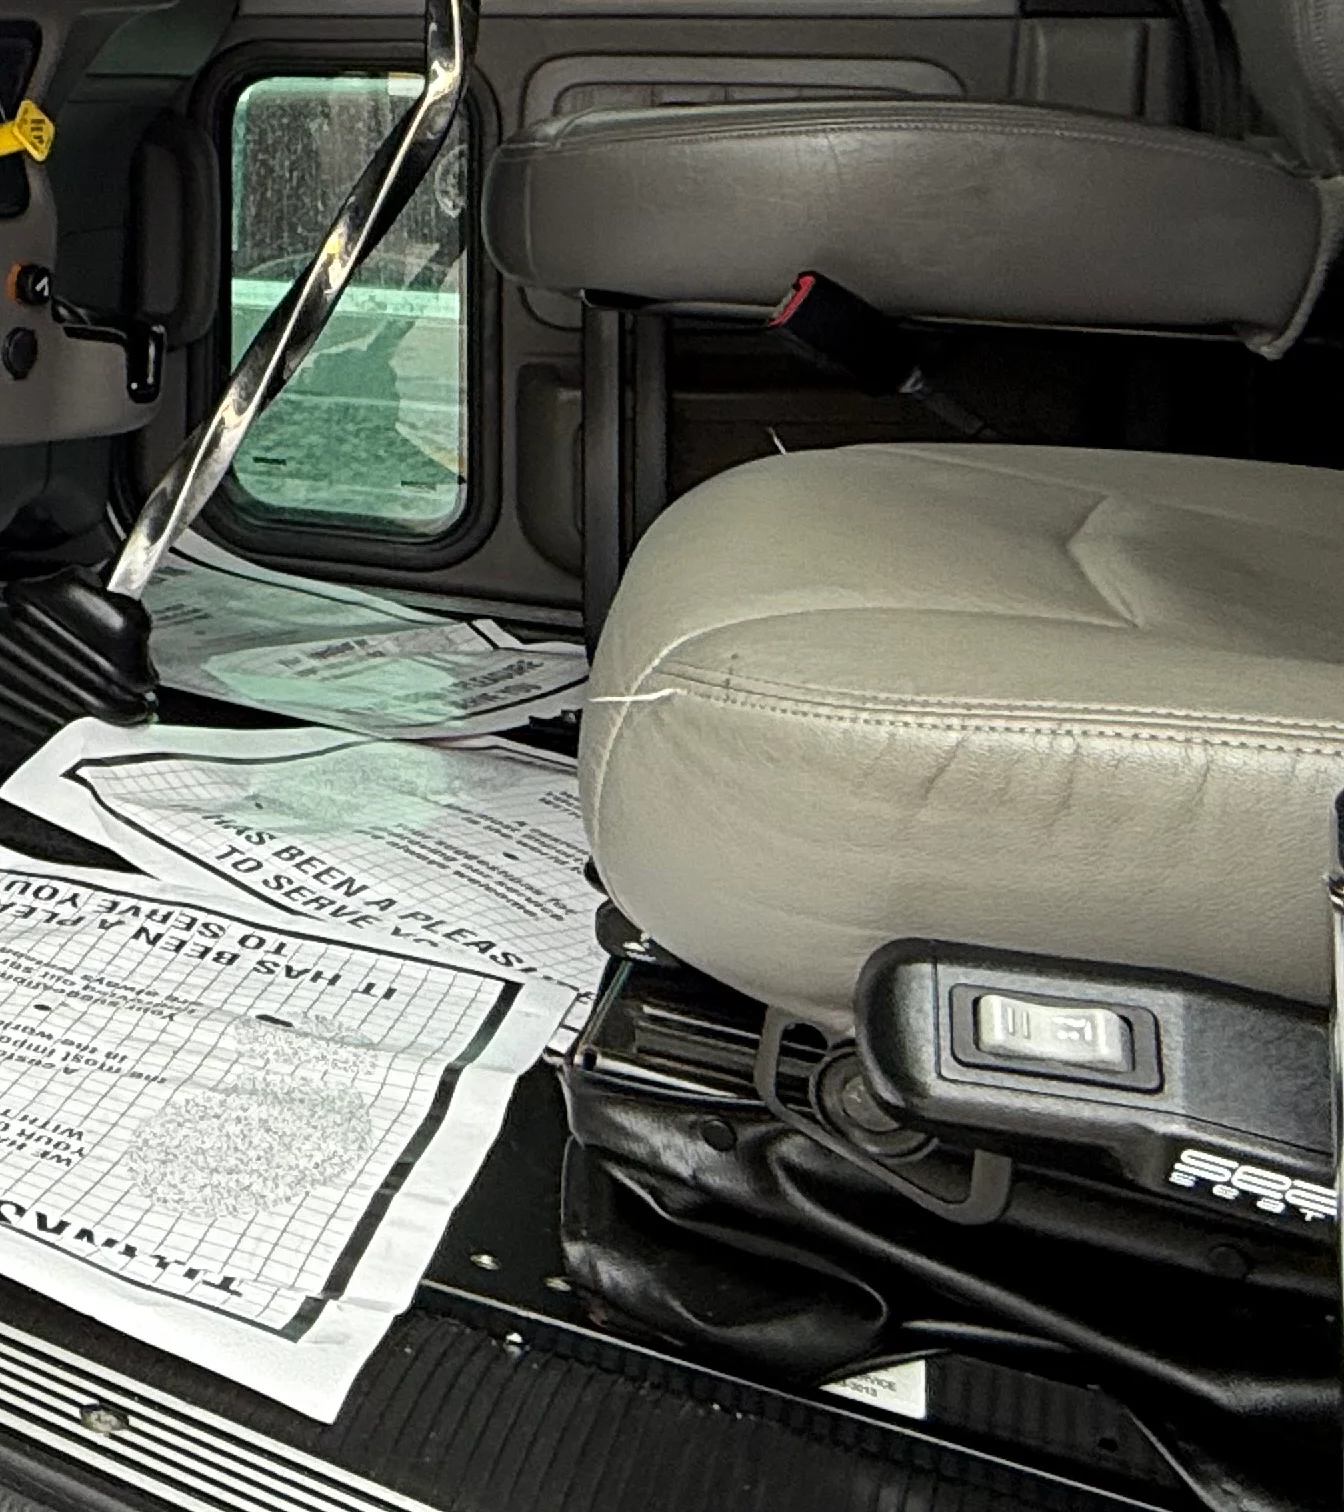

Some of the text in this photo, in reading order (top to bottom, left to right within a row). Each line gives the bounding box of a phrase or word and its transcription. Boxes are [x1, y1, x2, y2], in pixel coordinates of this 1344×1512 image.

[214, 844, 383, 930] TO SERVE
[271, 845, 371, 897] BEEN
[363, 897, 398, 912] A
[1, 878, 290, 958] TO SERVE YOU
[96, 916, 128, 933] A
[132, 926, 243, 968] BEEN
[253, 958, 343, 988] HAS
[353, 981, 399, 1001] IT
[61, 1050, 123, 1075] most
[18, 1115, 84, 1141] WITH
[16, 1129, 85, 1158] YOUR
[32, 1150, 72, 1168] WE
